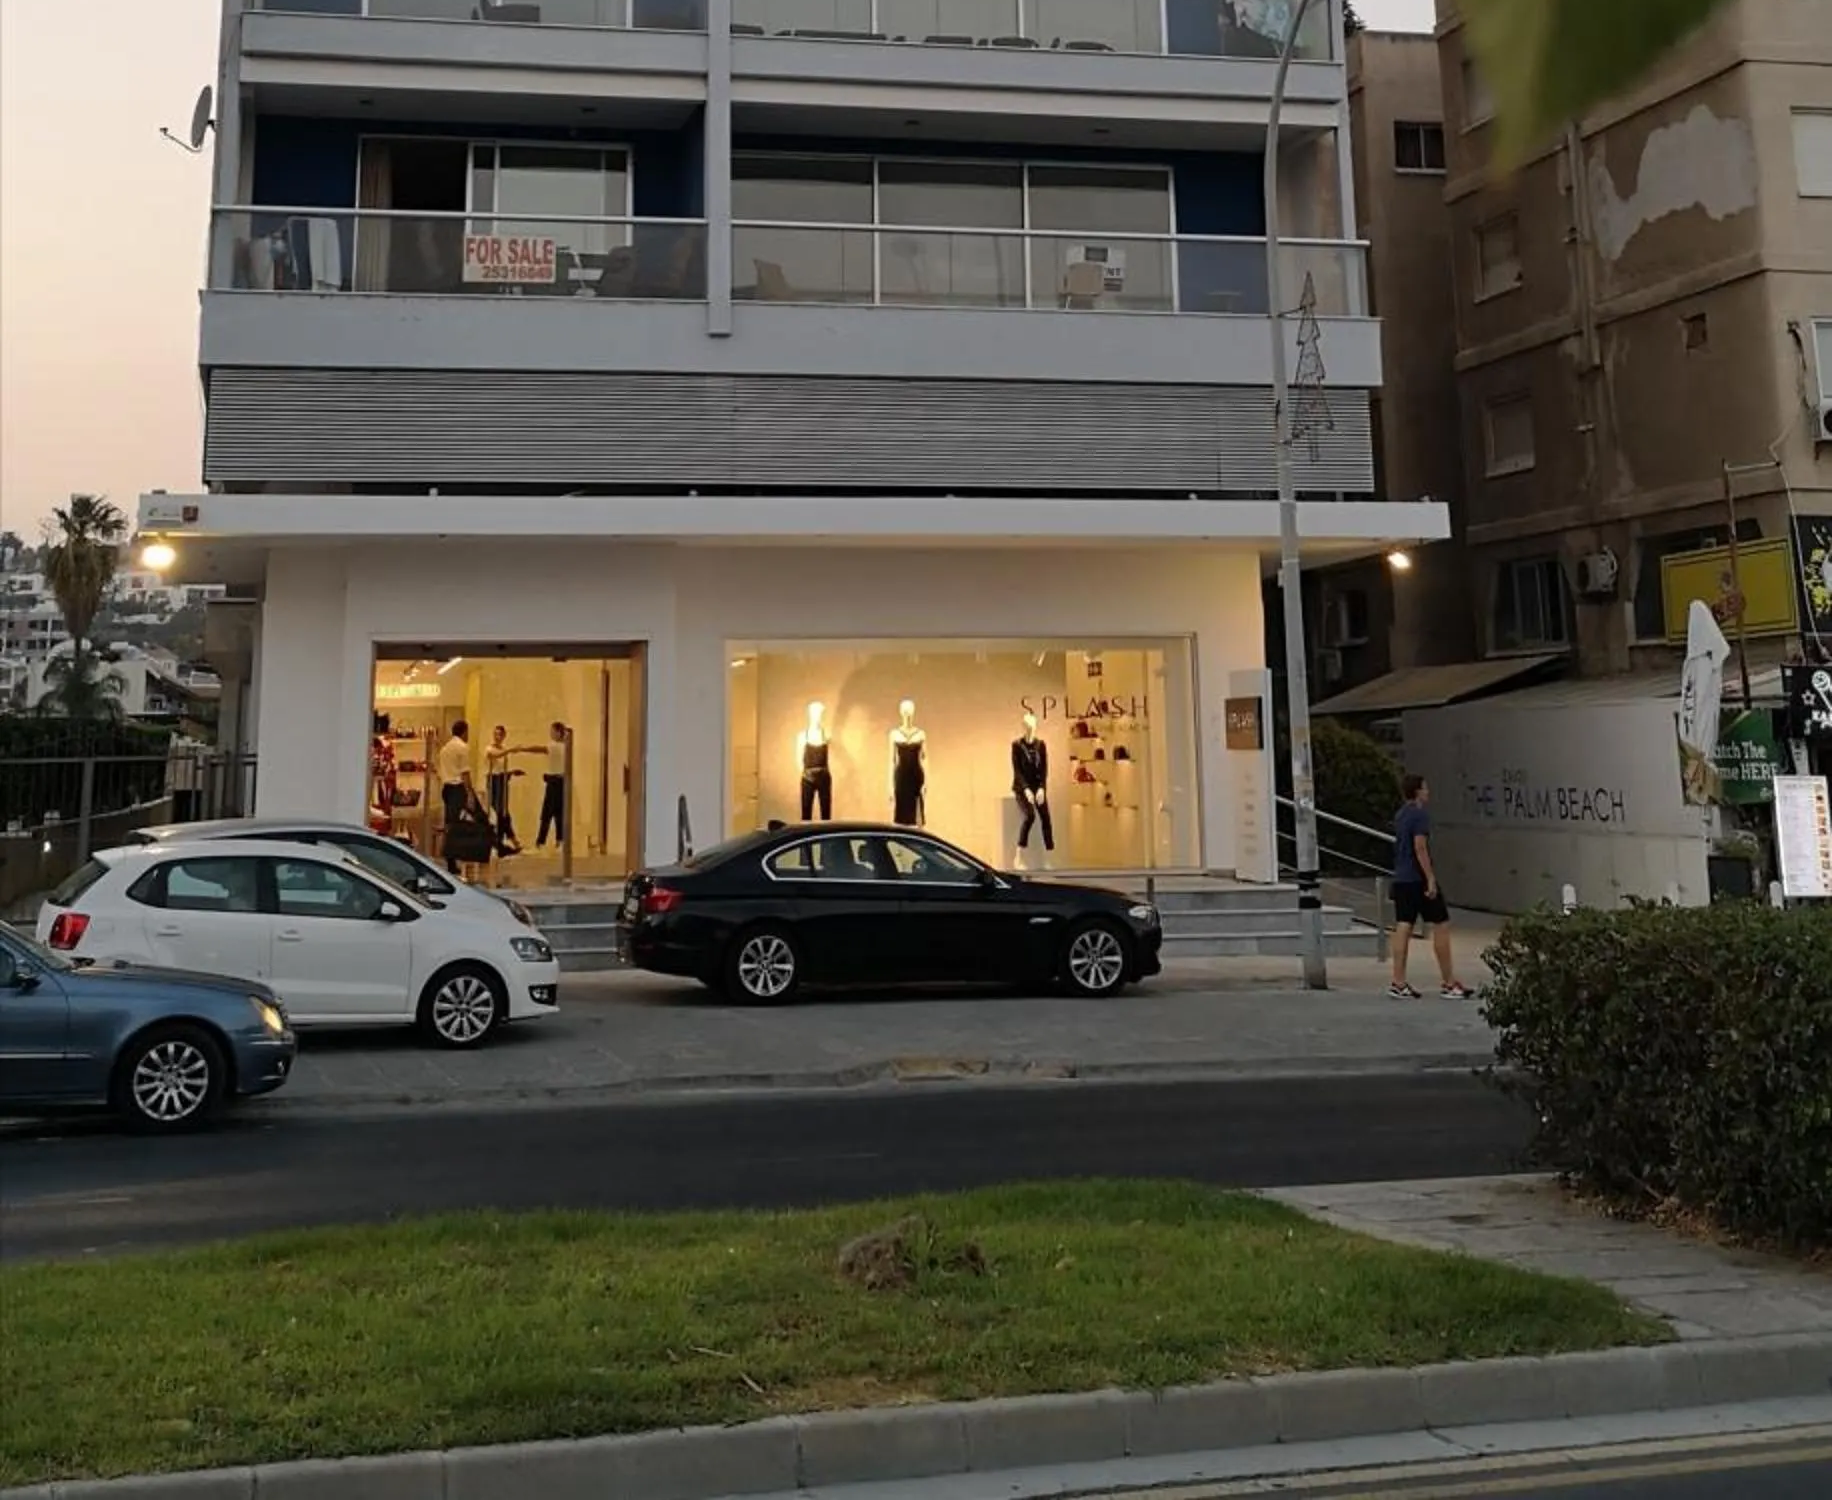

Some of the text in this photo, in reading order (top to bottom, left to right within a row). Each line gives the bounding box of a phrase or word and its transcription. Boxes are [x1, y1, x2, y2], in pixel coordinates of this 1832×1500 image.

[465, 237, 554, 265] FOR SALE
[1020, 695, 1148, 719] SPLASH
[1712, 740, 1767, 759] atch The
[1463, 784, 1626, 822] THE PALM BEACH
